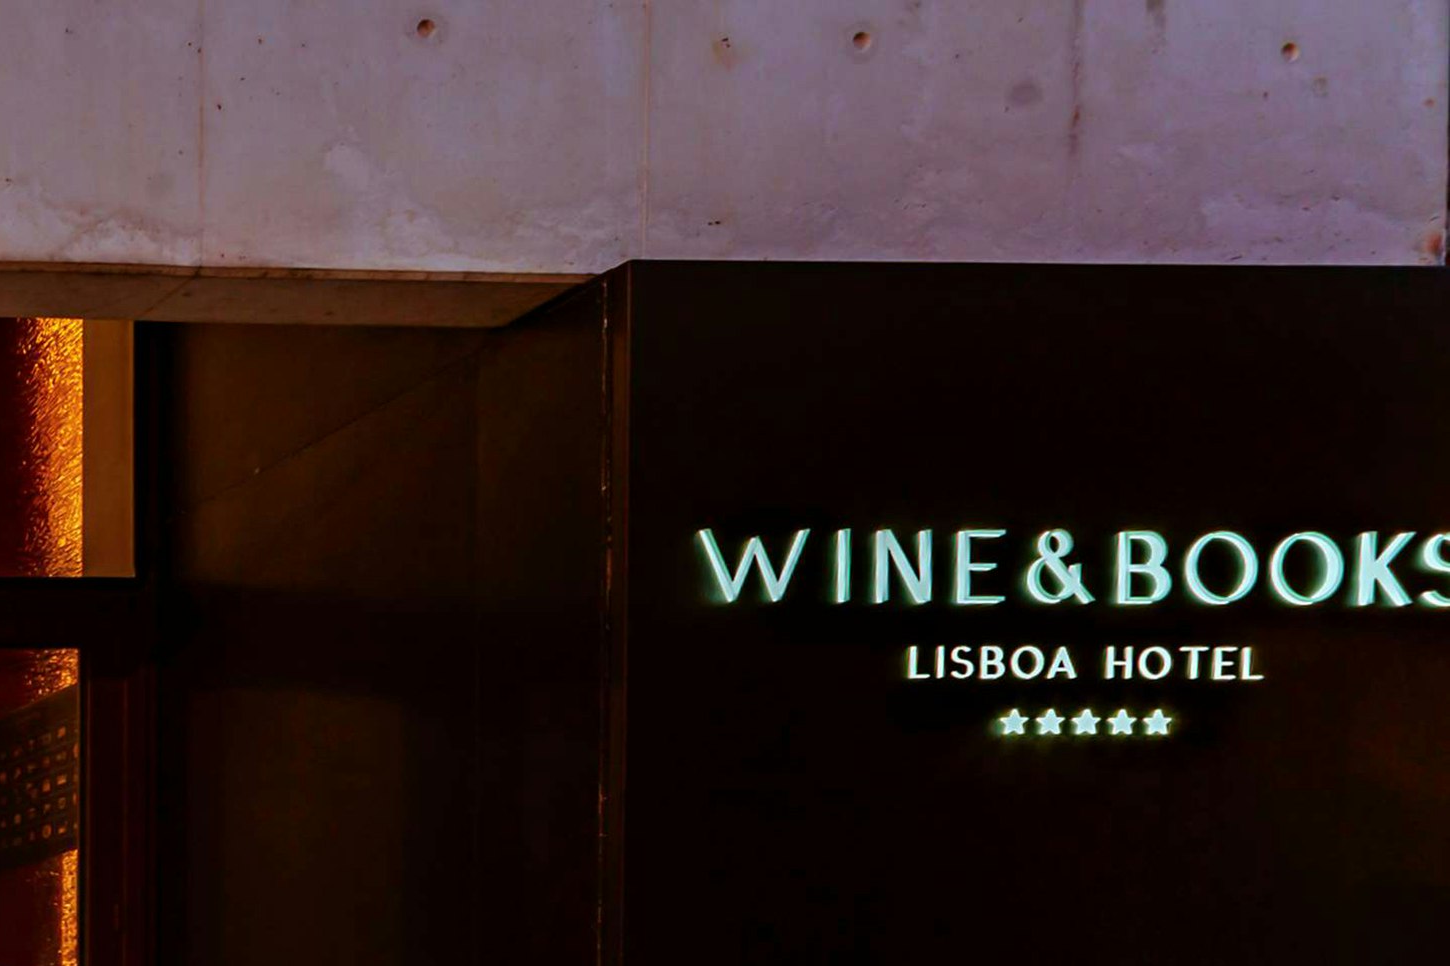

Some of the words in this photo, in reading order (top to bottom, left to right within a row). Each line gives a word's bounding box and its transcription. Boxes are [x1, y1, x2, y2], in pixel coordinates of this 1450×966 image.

[697, 528, 1450, 607] WINE&BOOKS
[907, 645, 1078, 681] LISBOA
[1104, 645, 1266, 681] HOTEL
